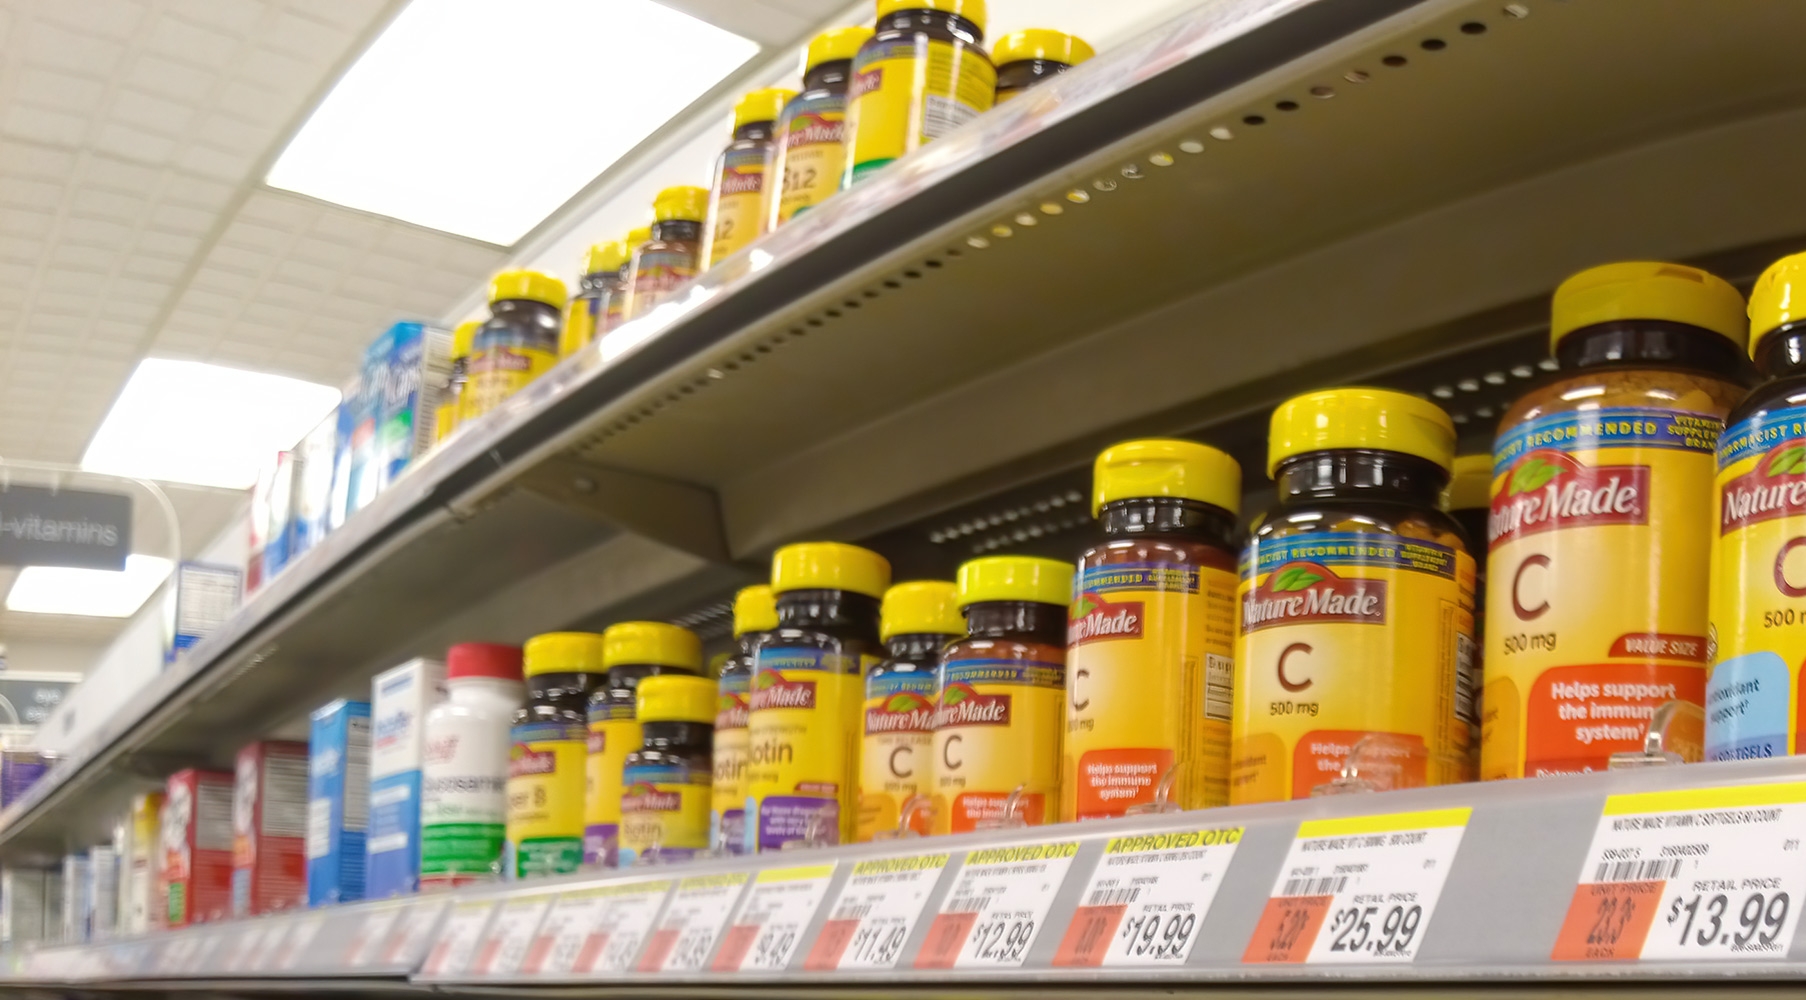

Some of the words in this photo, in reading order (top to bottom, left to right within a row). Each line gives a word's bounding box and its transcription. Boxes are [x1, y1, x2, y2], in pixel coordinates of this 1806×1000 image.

[1764, 608, 1795, 629] 500
[1123, 913, 1196, 956] $19.99
[1330, 905, 1421, 956] $25.99
[1667, 892, 1789, 946] $13.99
[972, 920, 1035, 962] $12.99
